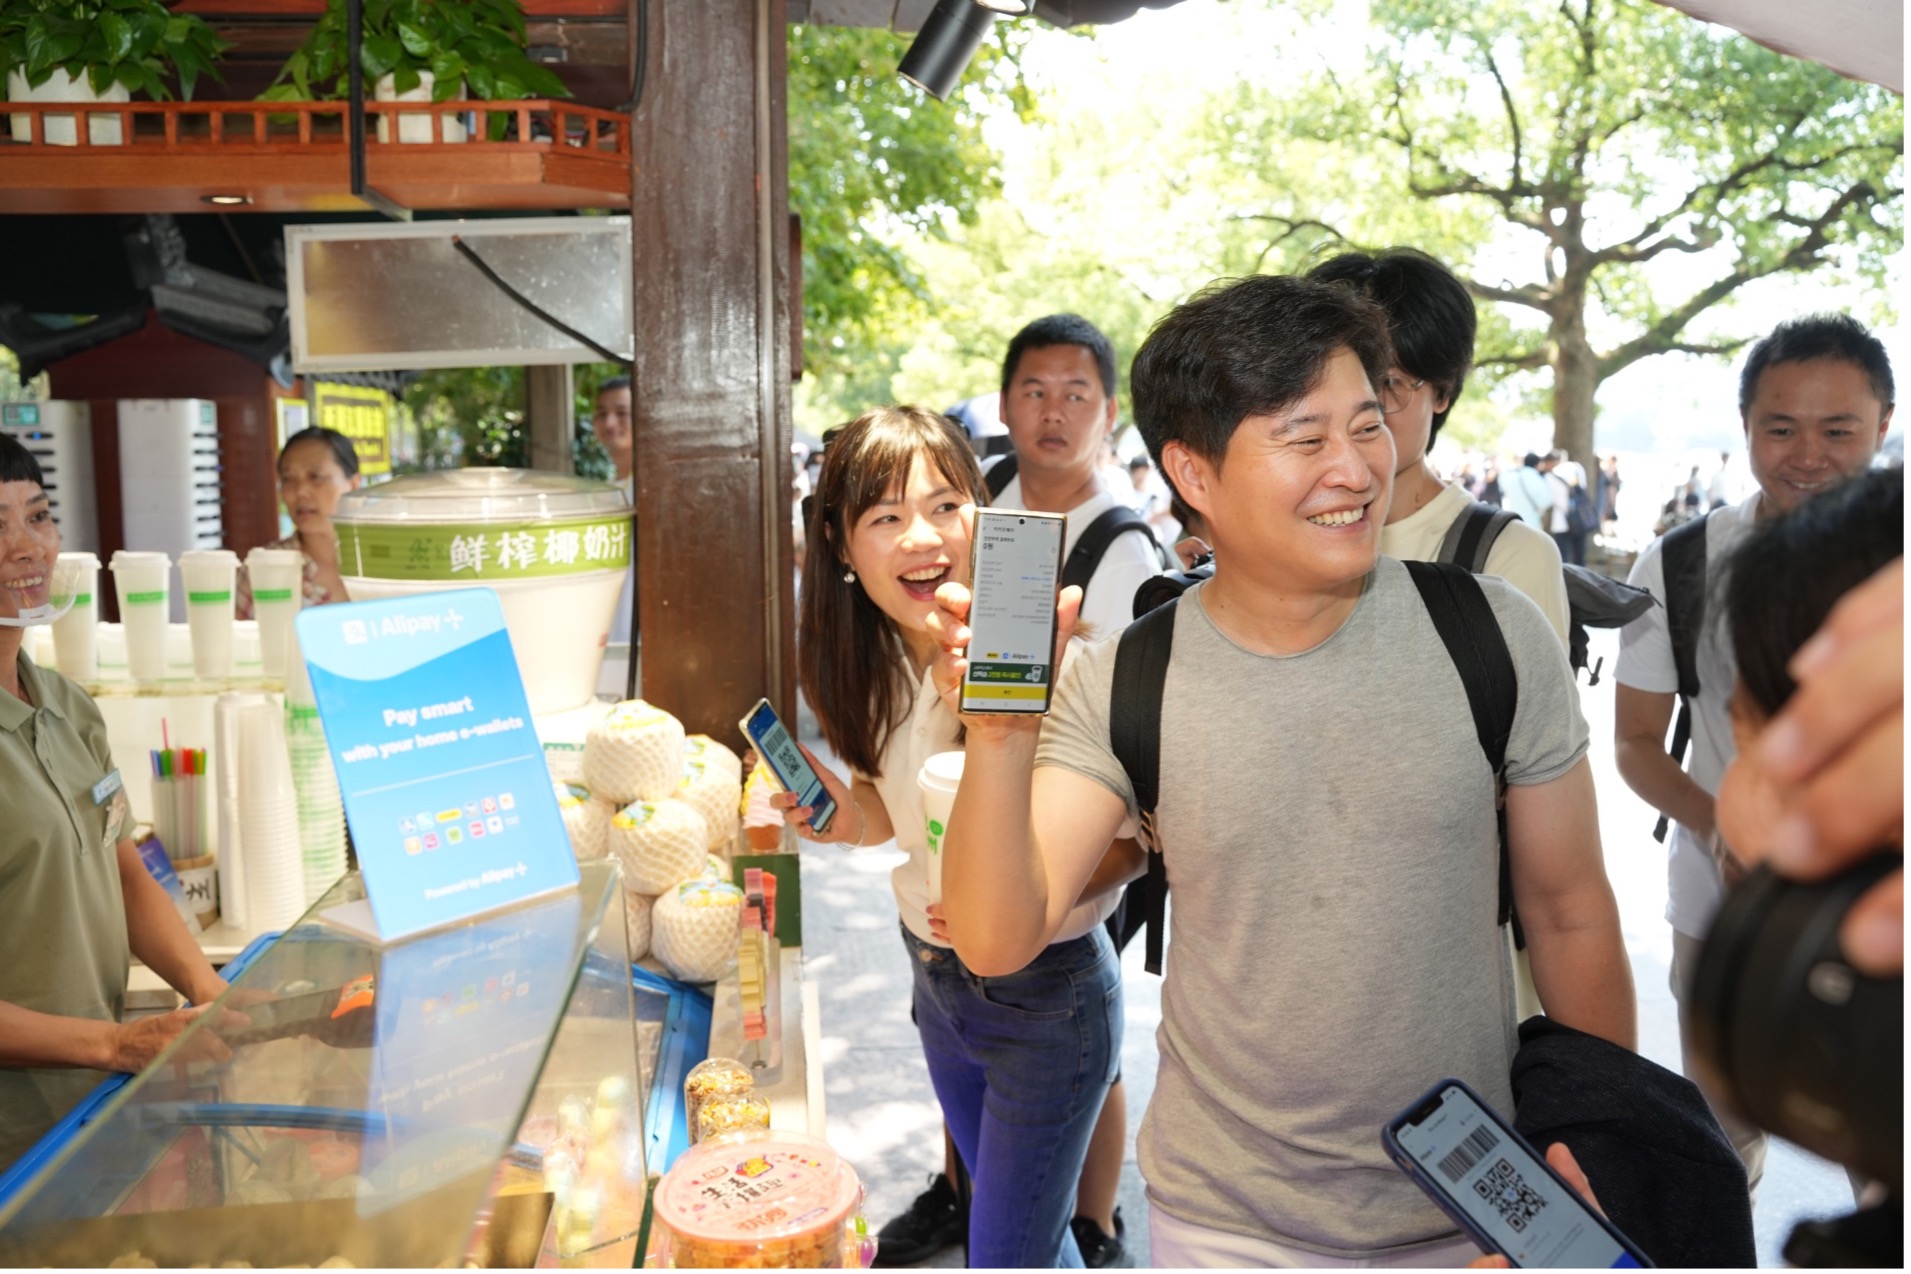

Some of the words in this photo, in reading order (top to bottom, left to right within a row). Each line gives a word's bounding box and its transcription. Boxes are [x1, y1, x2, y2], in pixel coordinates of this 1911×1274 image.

[450, 523, 627, 573] 鲜榨椰奶汁
[382, 708, 418, 727] Pay
[420, 696, 474, 720] smart
[341, 743, 378, 763] with
[379, 737, 414, 759] your
[415, 729, 458, 749] home
[459, 716, 525, 740] e-wallets
